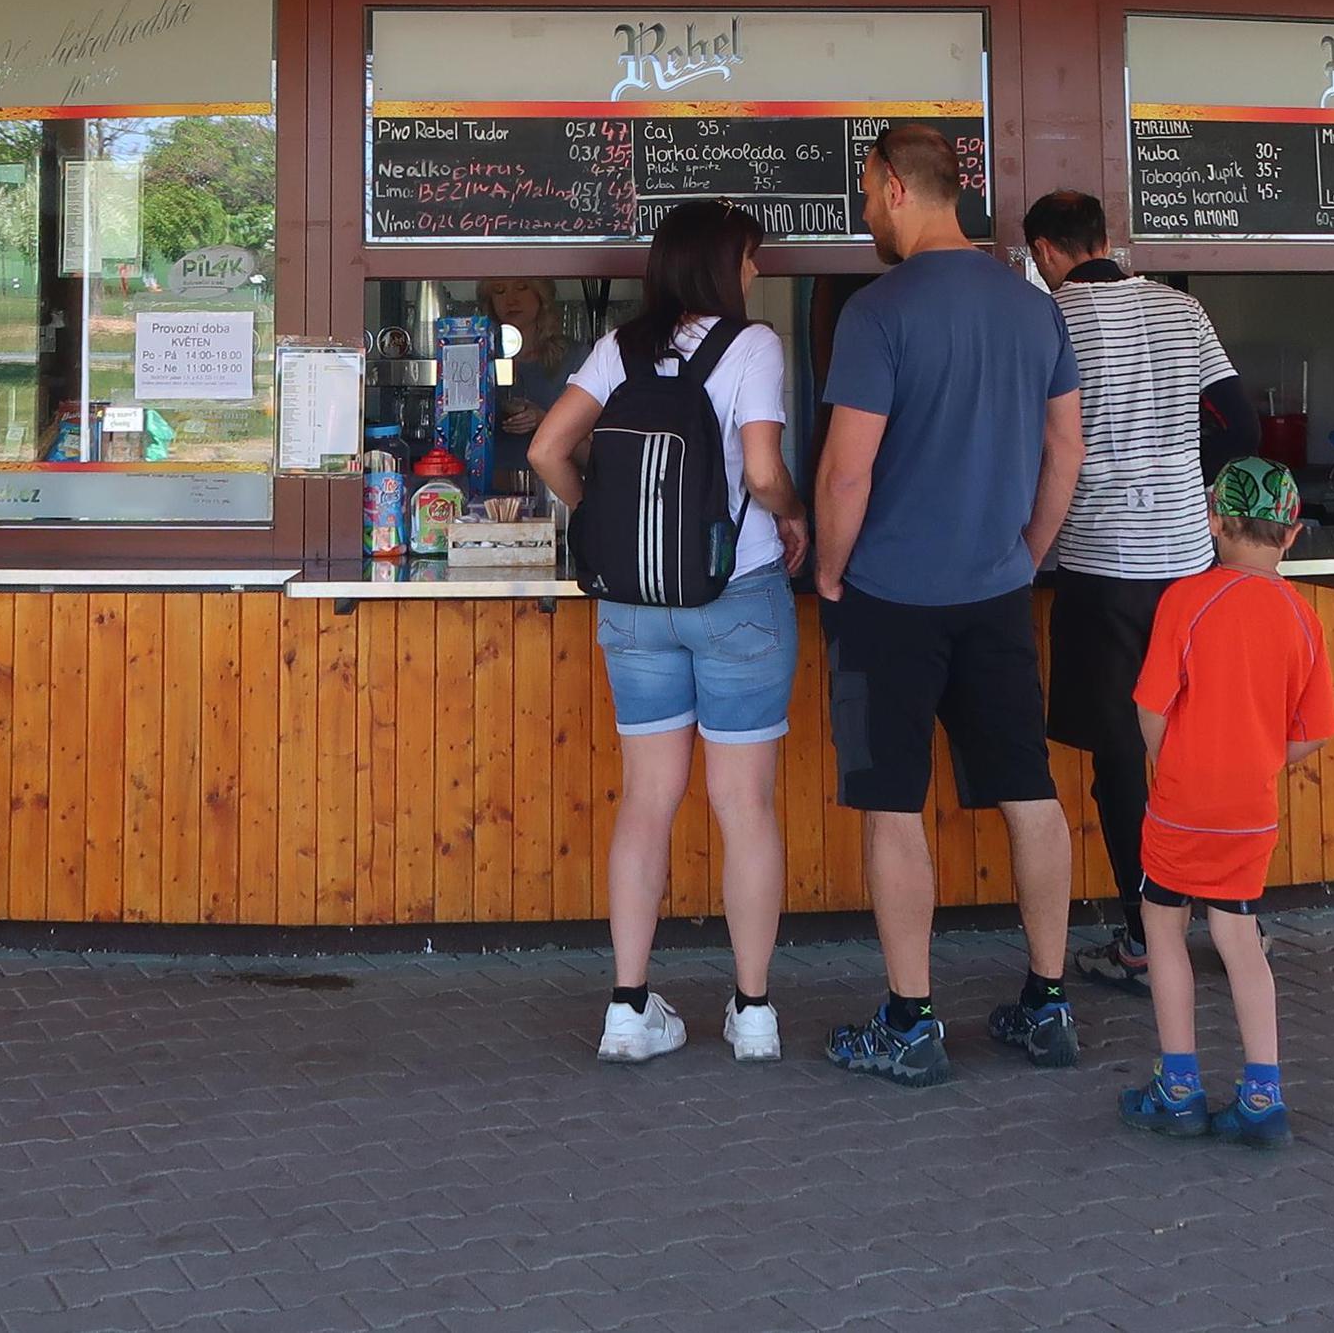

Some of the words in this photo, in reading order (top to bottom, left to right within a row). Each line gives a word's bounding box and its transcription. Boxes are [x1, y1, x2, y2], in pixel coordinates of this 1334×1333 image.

[611, 15, 745, 102] Rebel
[378, 120, 411, 141] Pivo
[415, 120, 459, 141] Rebel
[463, 122, 509, 141] Tudor
[644, 121, 674, 143] Čaj
[697, 120, 730, 137] 35,-
[645, 143, 700, 163] Horká
[702, 142, 786, 162] čokoláda
[796, 144, 833, 162] 65,-
[1137, 144, 1180, 162] Kuba
[1255, 142, 1283, 160] 30,-
[749, 161, 780, 176] 90,-
[1207, 161, 1244, 184] Jupík
[1255, 162, 1282, 178] 35,-
[753, 176, 782, 192] 75,-
[1141, 191, 1188, 209] Pegas
[1192, 183, 1250, 205] kornout
[1257, 183, 1283, 201] 45,-
[1143, 212, 1189, 229] Pegas
[1194, 209, 1240, 228] ALMOND
[152, 322, 199, 334] Provozní
[202, 323, 230, 334] doba
[142, 350, 155, 361] Po
[164, 350, 178, 361] Pá
[141, 363, 155, 374] So
[164, 363, 178, 374] Ne
